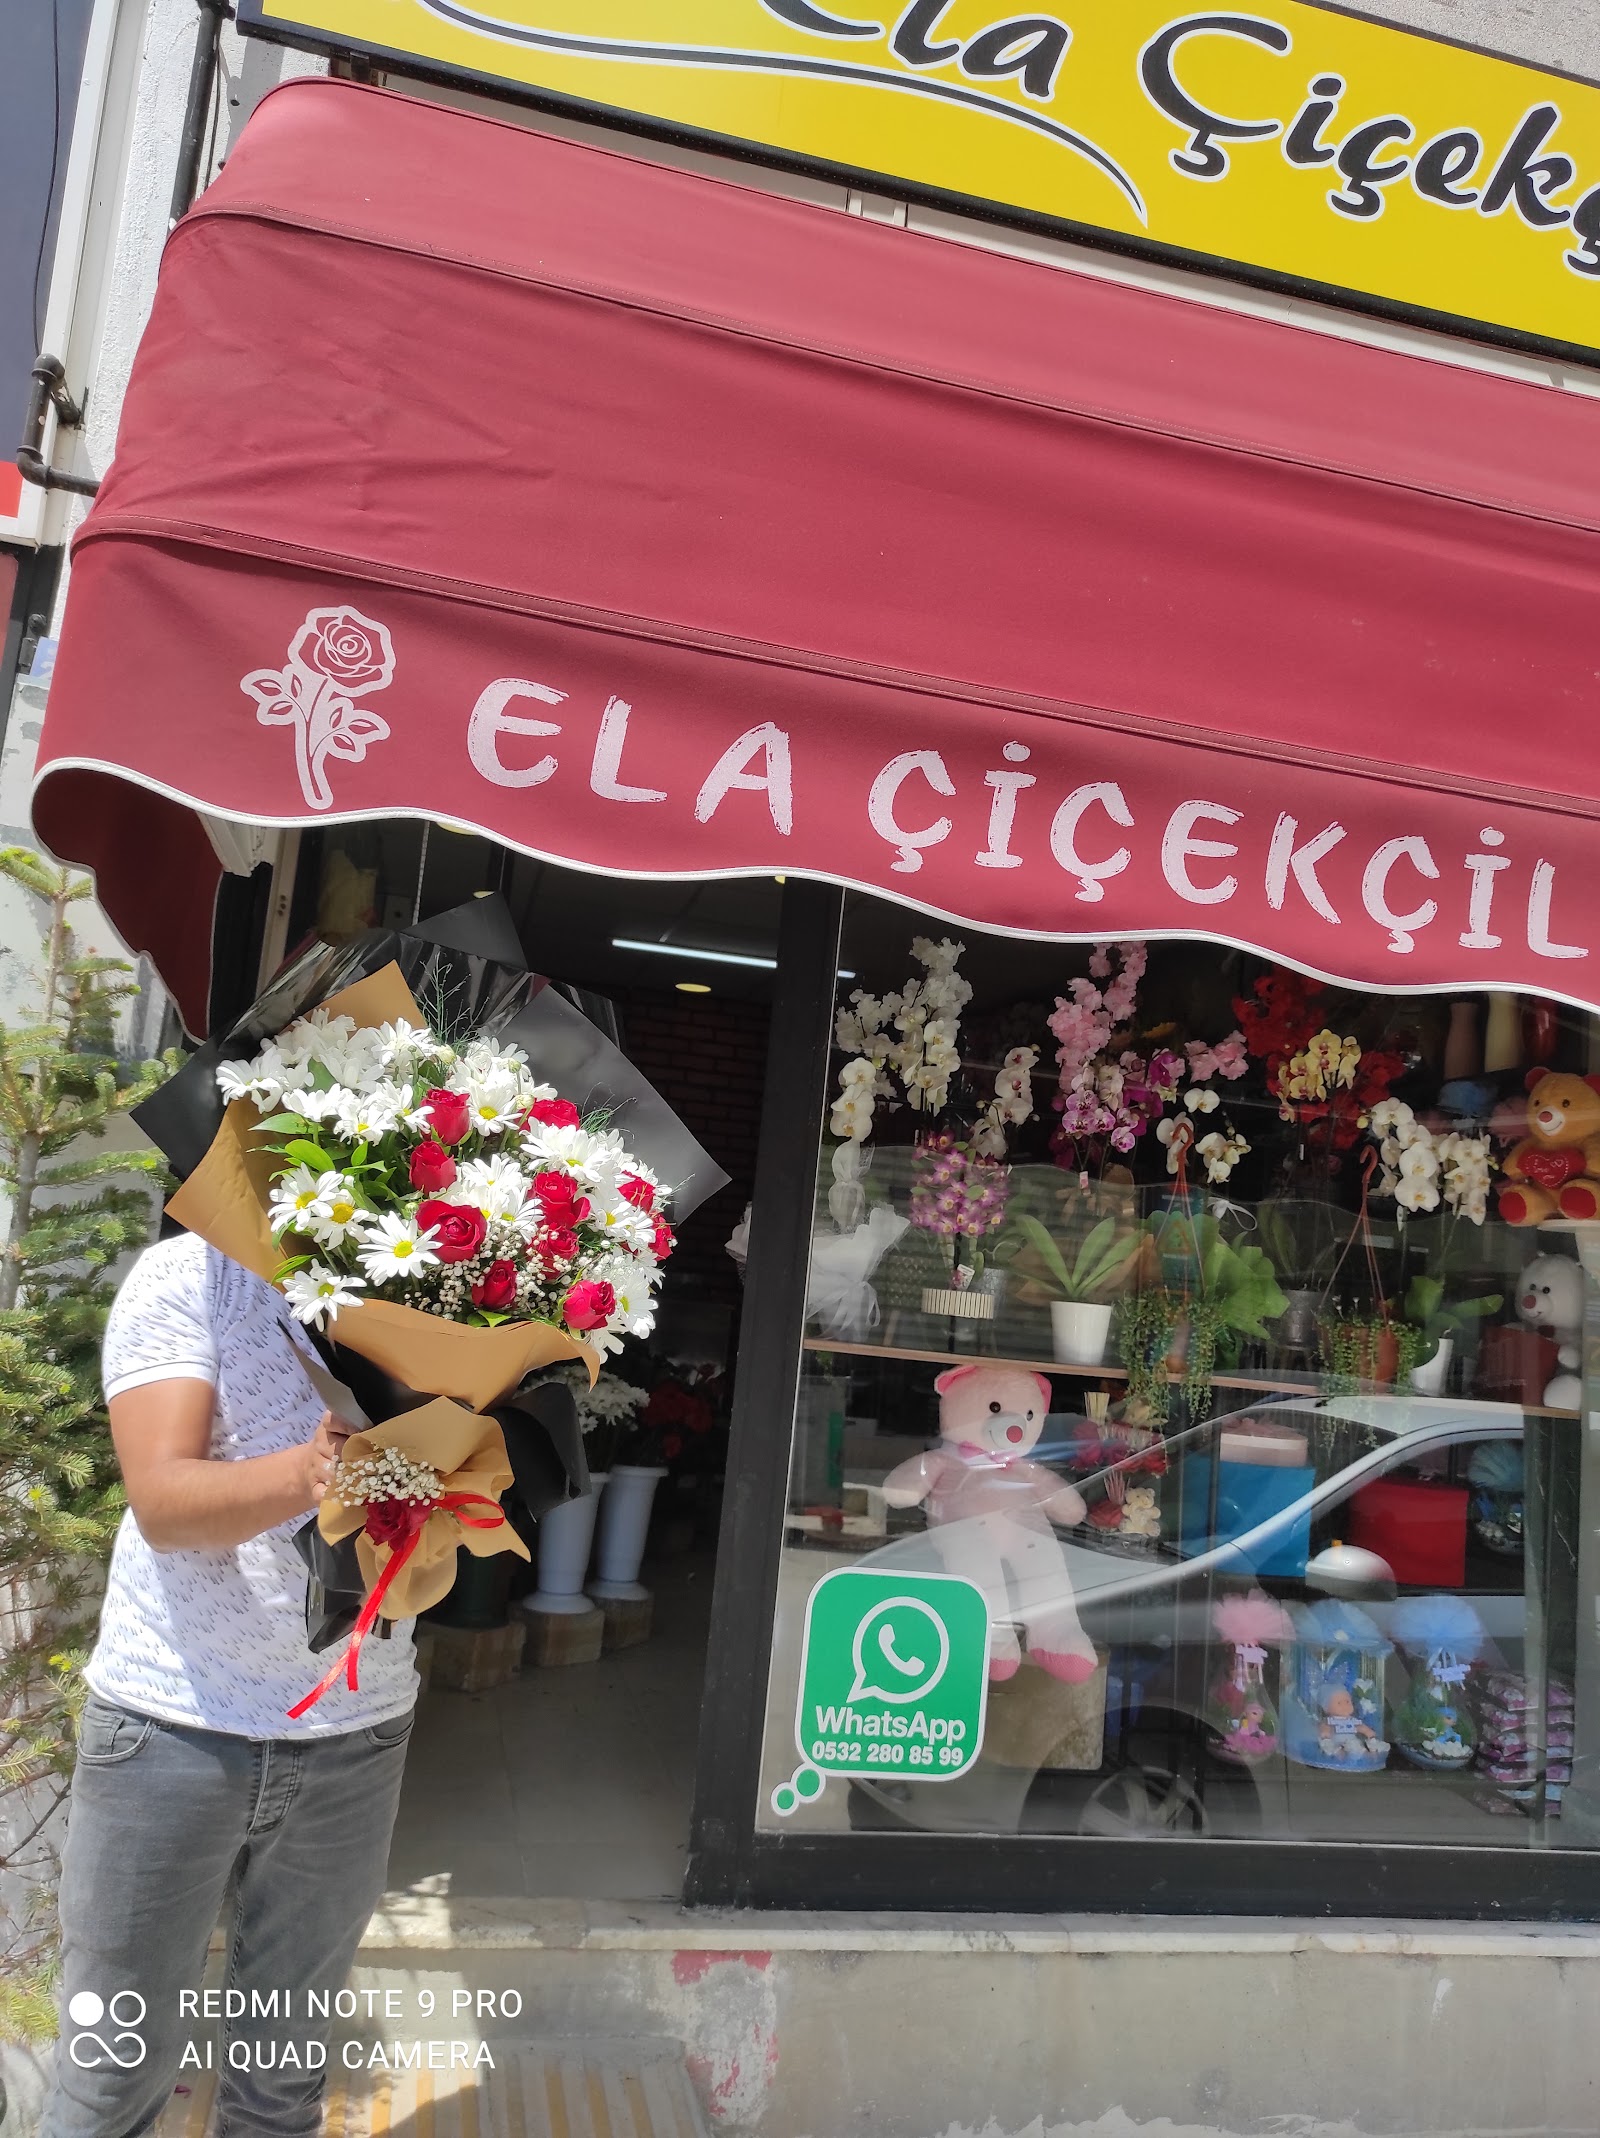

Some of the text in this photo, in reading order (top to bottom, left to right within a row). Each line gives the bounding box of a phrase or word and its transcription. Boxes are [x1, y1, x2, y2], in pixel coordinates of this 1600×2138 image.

[467, 677, 1590, 960] ELA ÇİÇEKÇİL
[815, 1705, 967, 1747] WhatsApp
[811, 1740, 964, 1767] 0532 280 85 99
